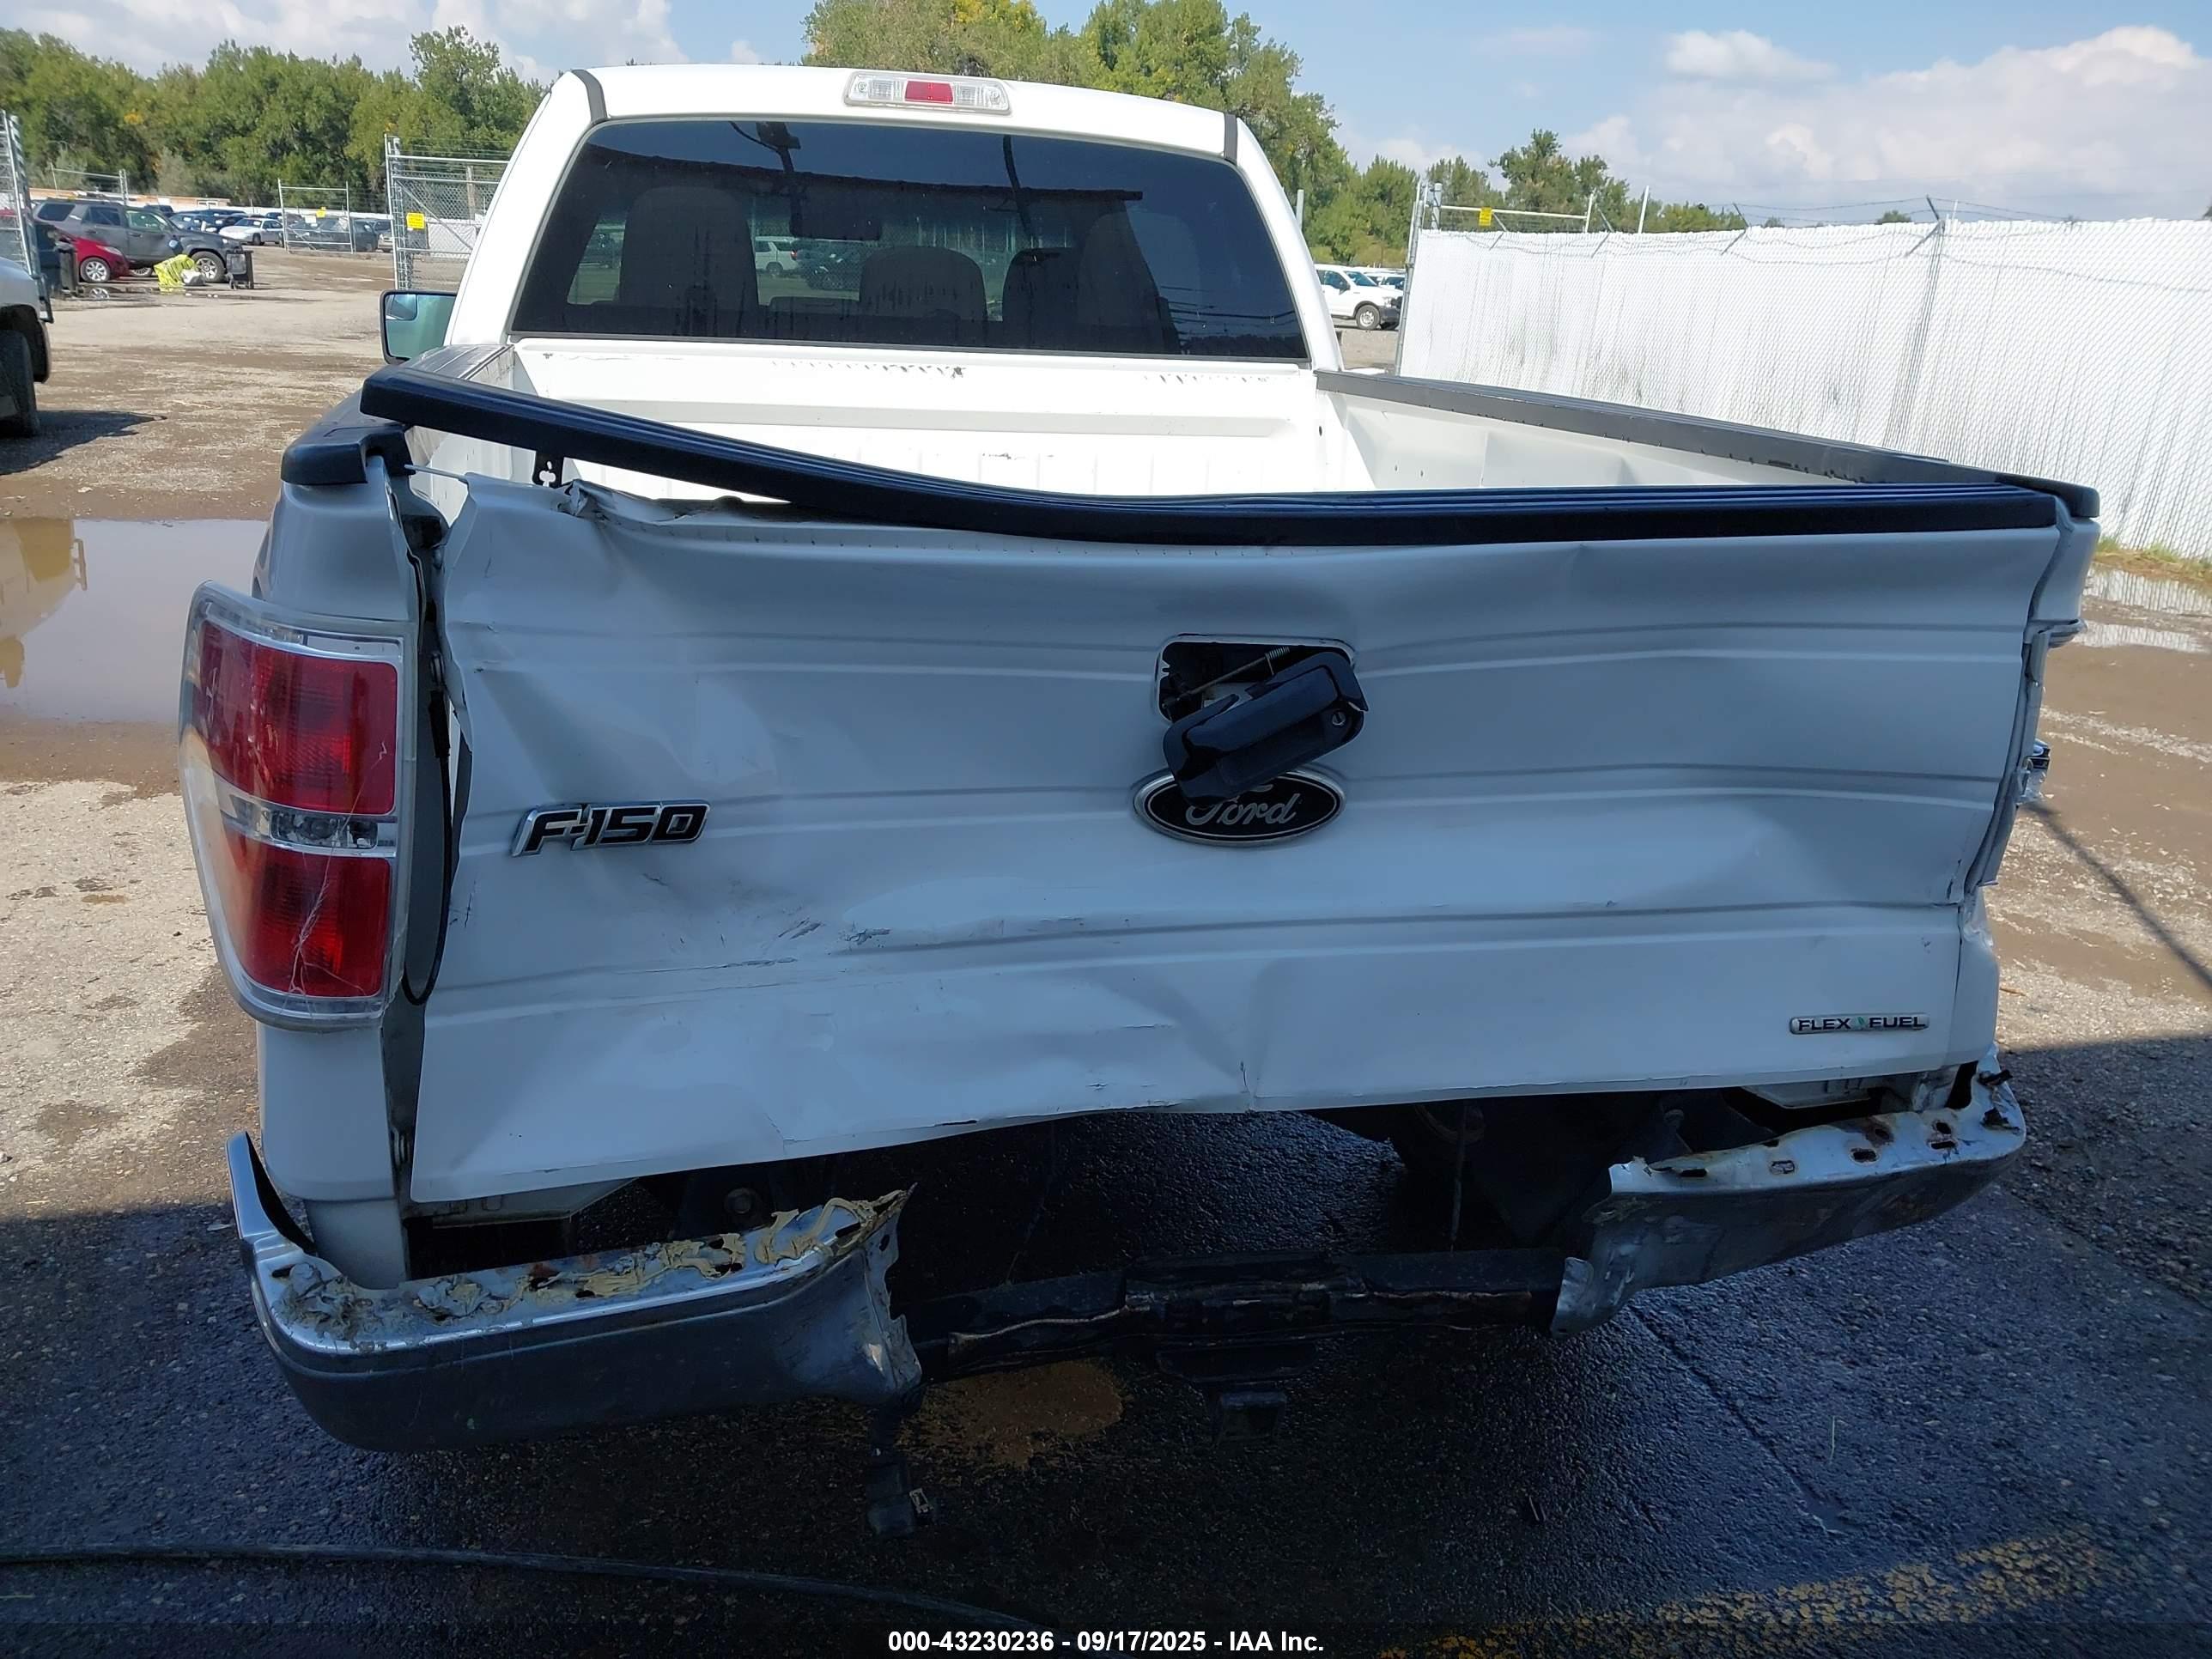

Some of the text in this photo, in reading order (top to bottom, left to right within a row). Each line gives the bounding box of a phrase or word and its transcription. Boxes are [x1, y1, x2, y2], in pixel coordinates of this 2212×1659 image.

[512, 804, 710, 857] F-150
[1798, 1016, 1926, 1031] FLEX FUEL
